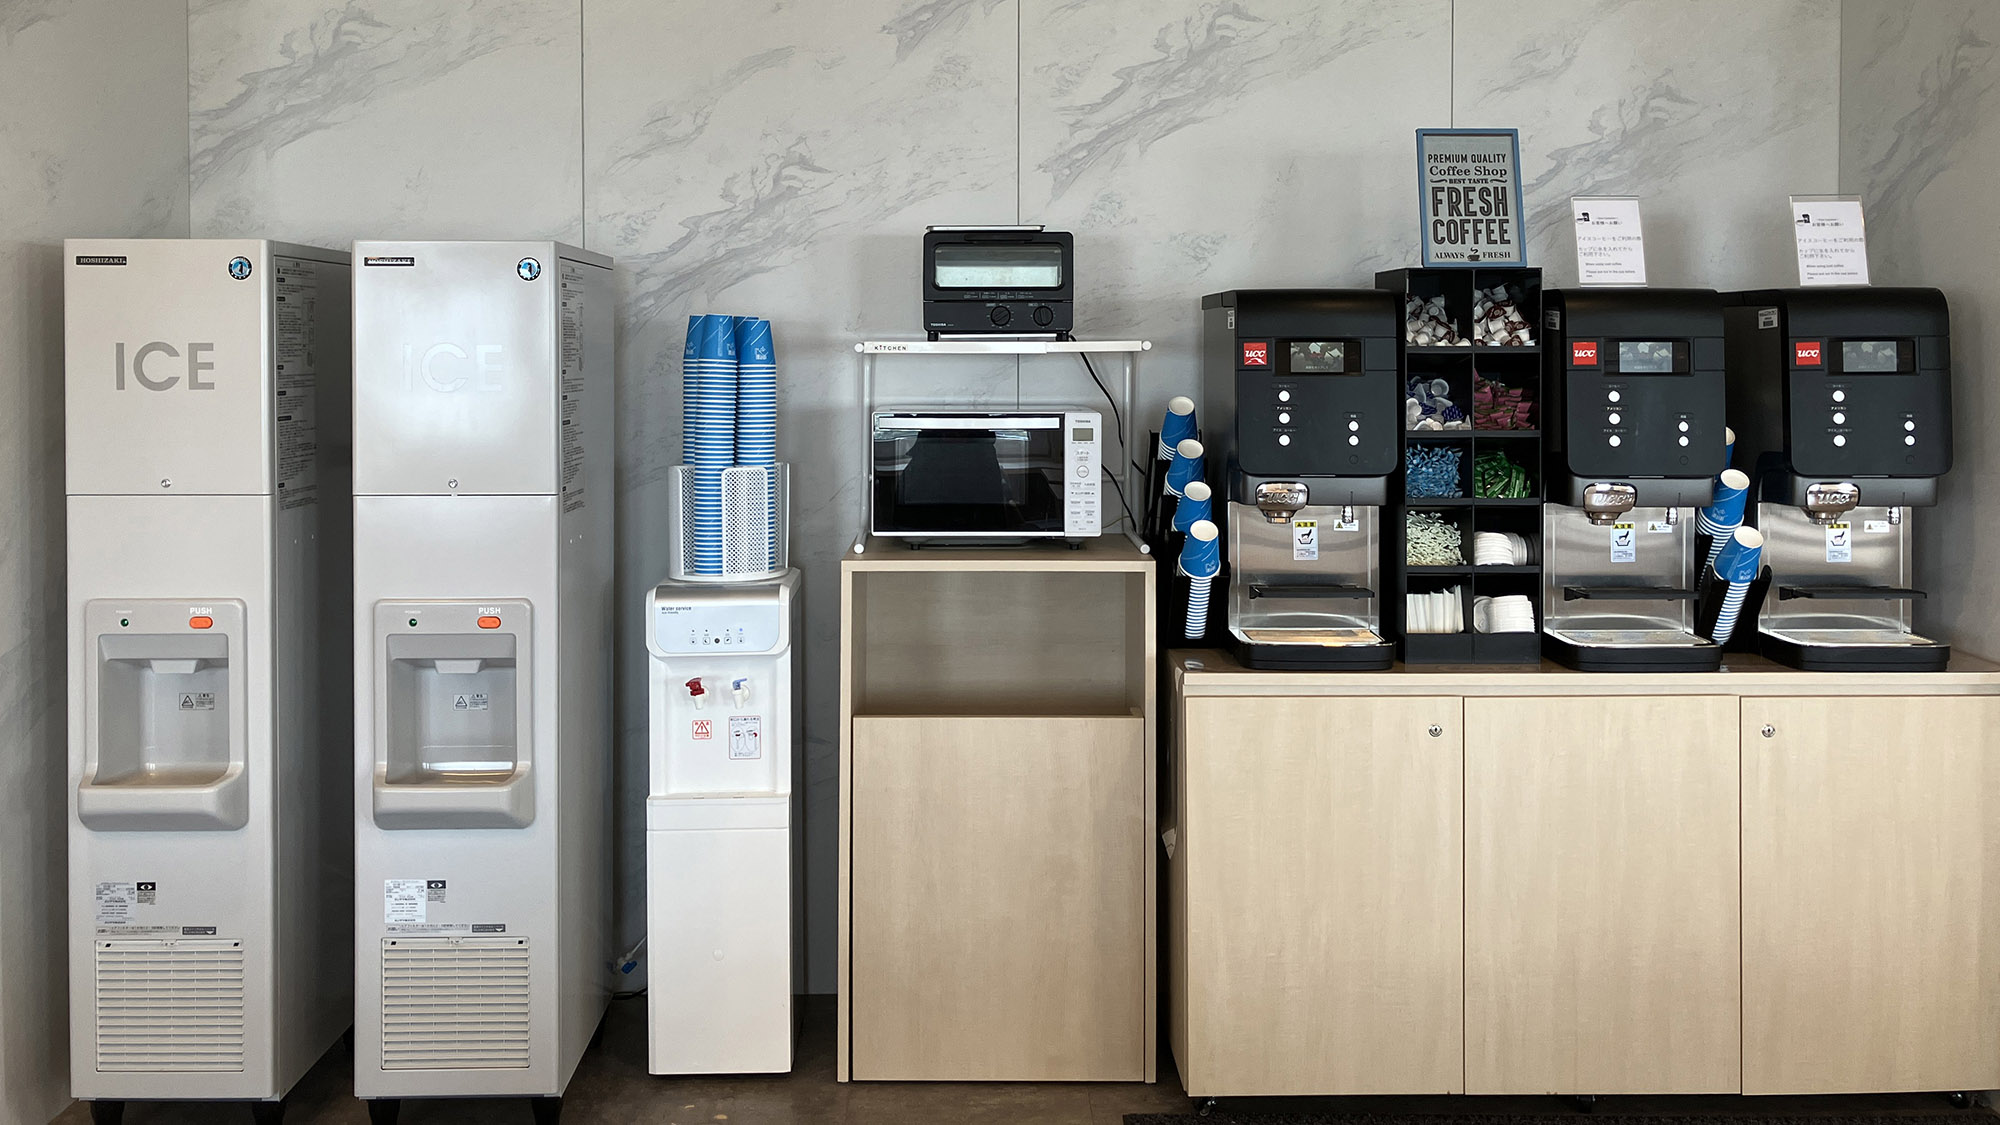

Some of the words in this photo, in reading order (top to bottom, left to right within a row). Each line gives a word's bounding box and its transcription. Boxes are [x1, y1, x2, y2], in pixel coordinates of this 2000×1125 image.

[1427, 153, 1468, 163] PREMIUM
[1471, 153, 1506, 163] QUALITY
[1429, 166, 1471, 176] Coffee
[1474, 166, 1507, 178] Shop
[1431, 186, 1508, 217] FRESH
[1432, 219, 1511, 245] COFFEE
[115, 341, 215, 392] ICE
[402, 342, 503, 392] ICE
[189, 607, 213, 615] PUSH
[478, 607, 501, 615] PUSH
